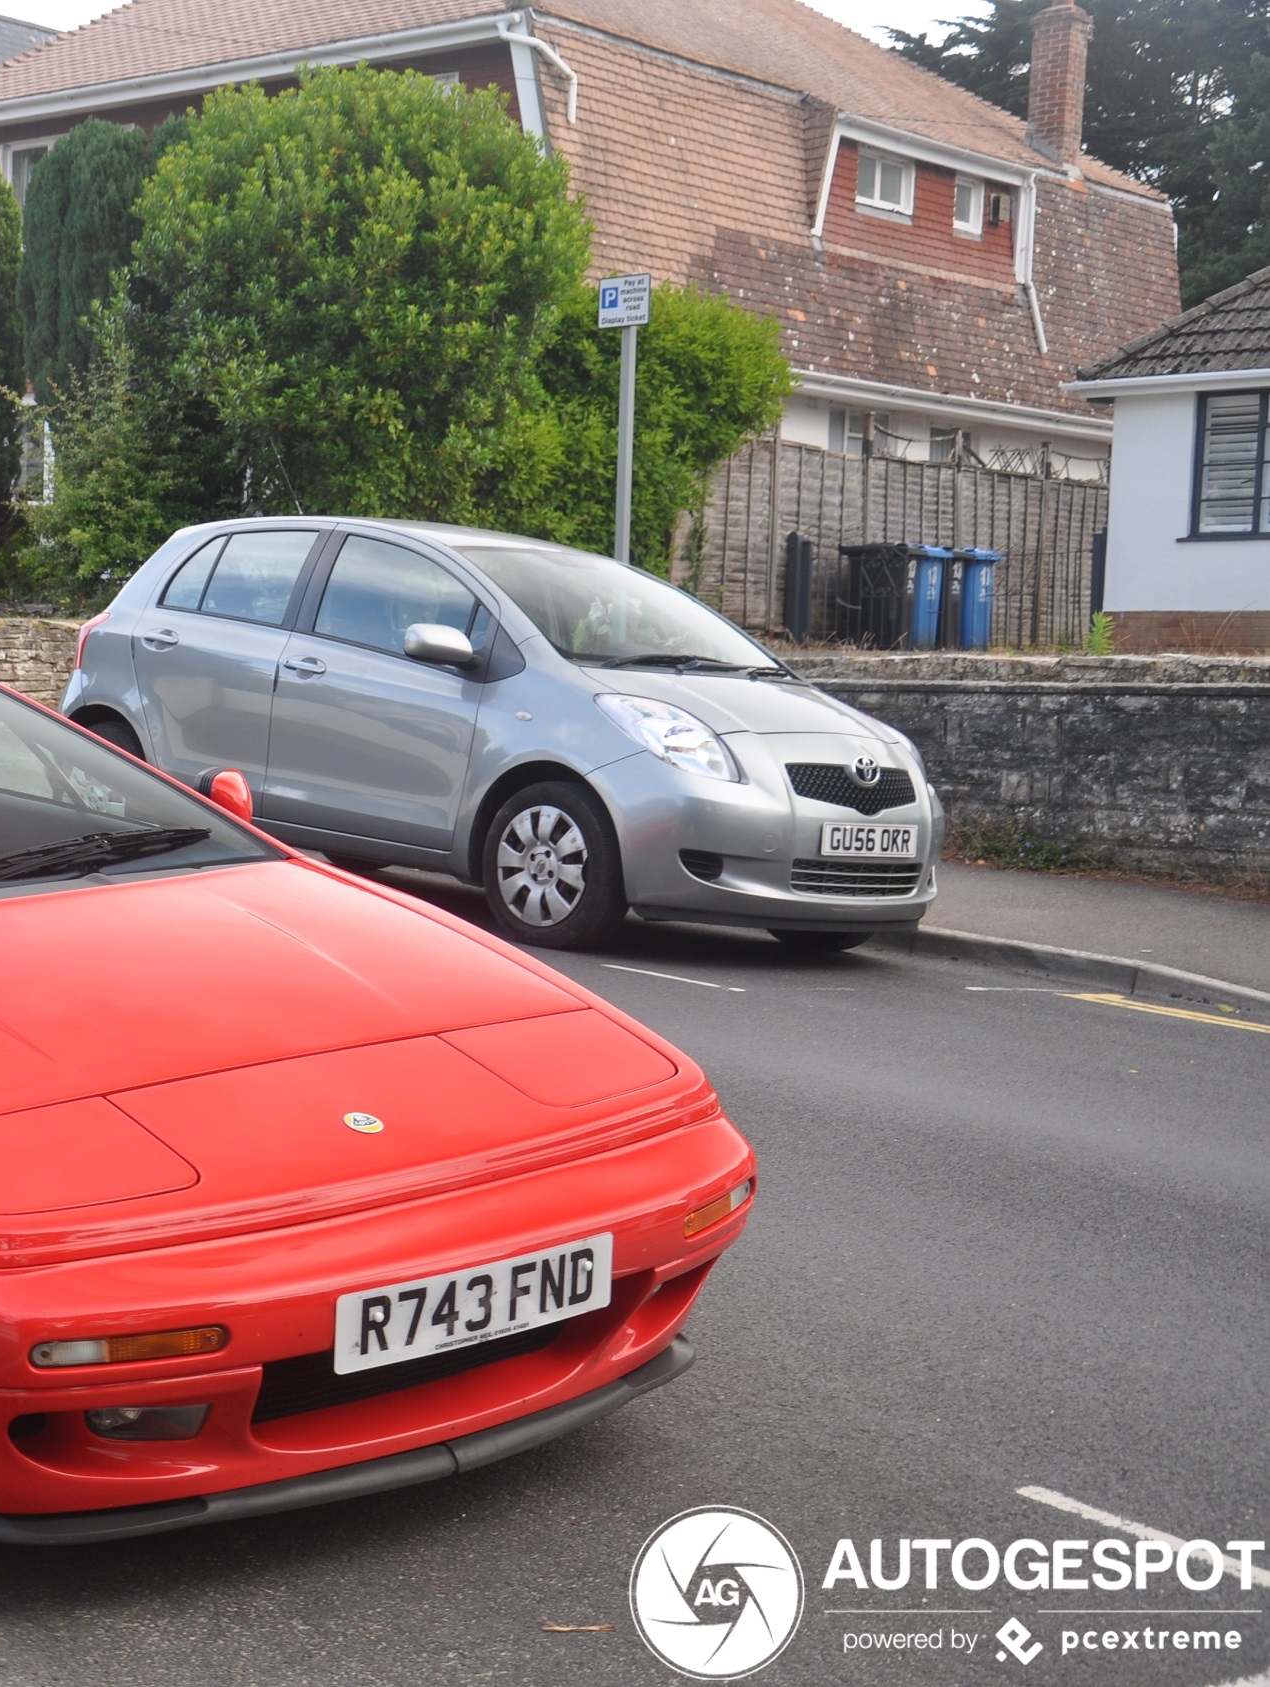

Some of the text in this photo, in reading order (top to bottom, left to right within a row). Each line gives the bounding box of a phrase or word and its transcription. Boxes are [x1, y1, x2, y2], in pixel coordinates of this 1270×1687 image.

[601, 317, 625, 325] Display
[830, 827, 911, 853] GU56 OKR
[360, 1248, 594, 1355] R743 FND
[435, 1335, 478, 1350] CHRISTOPHER
